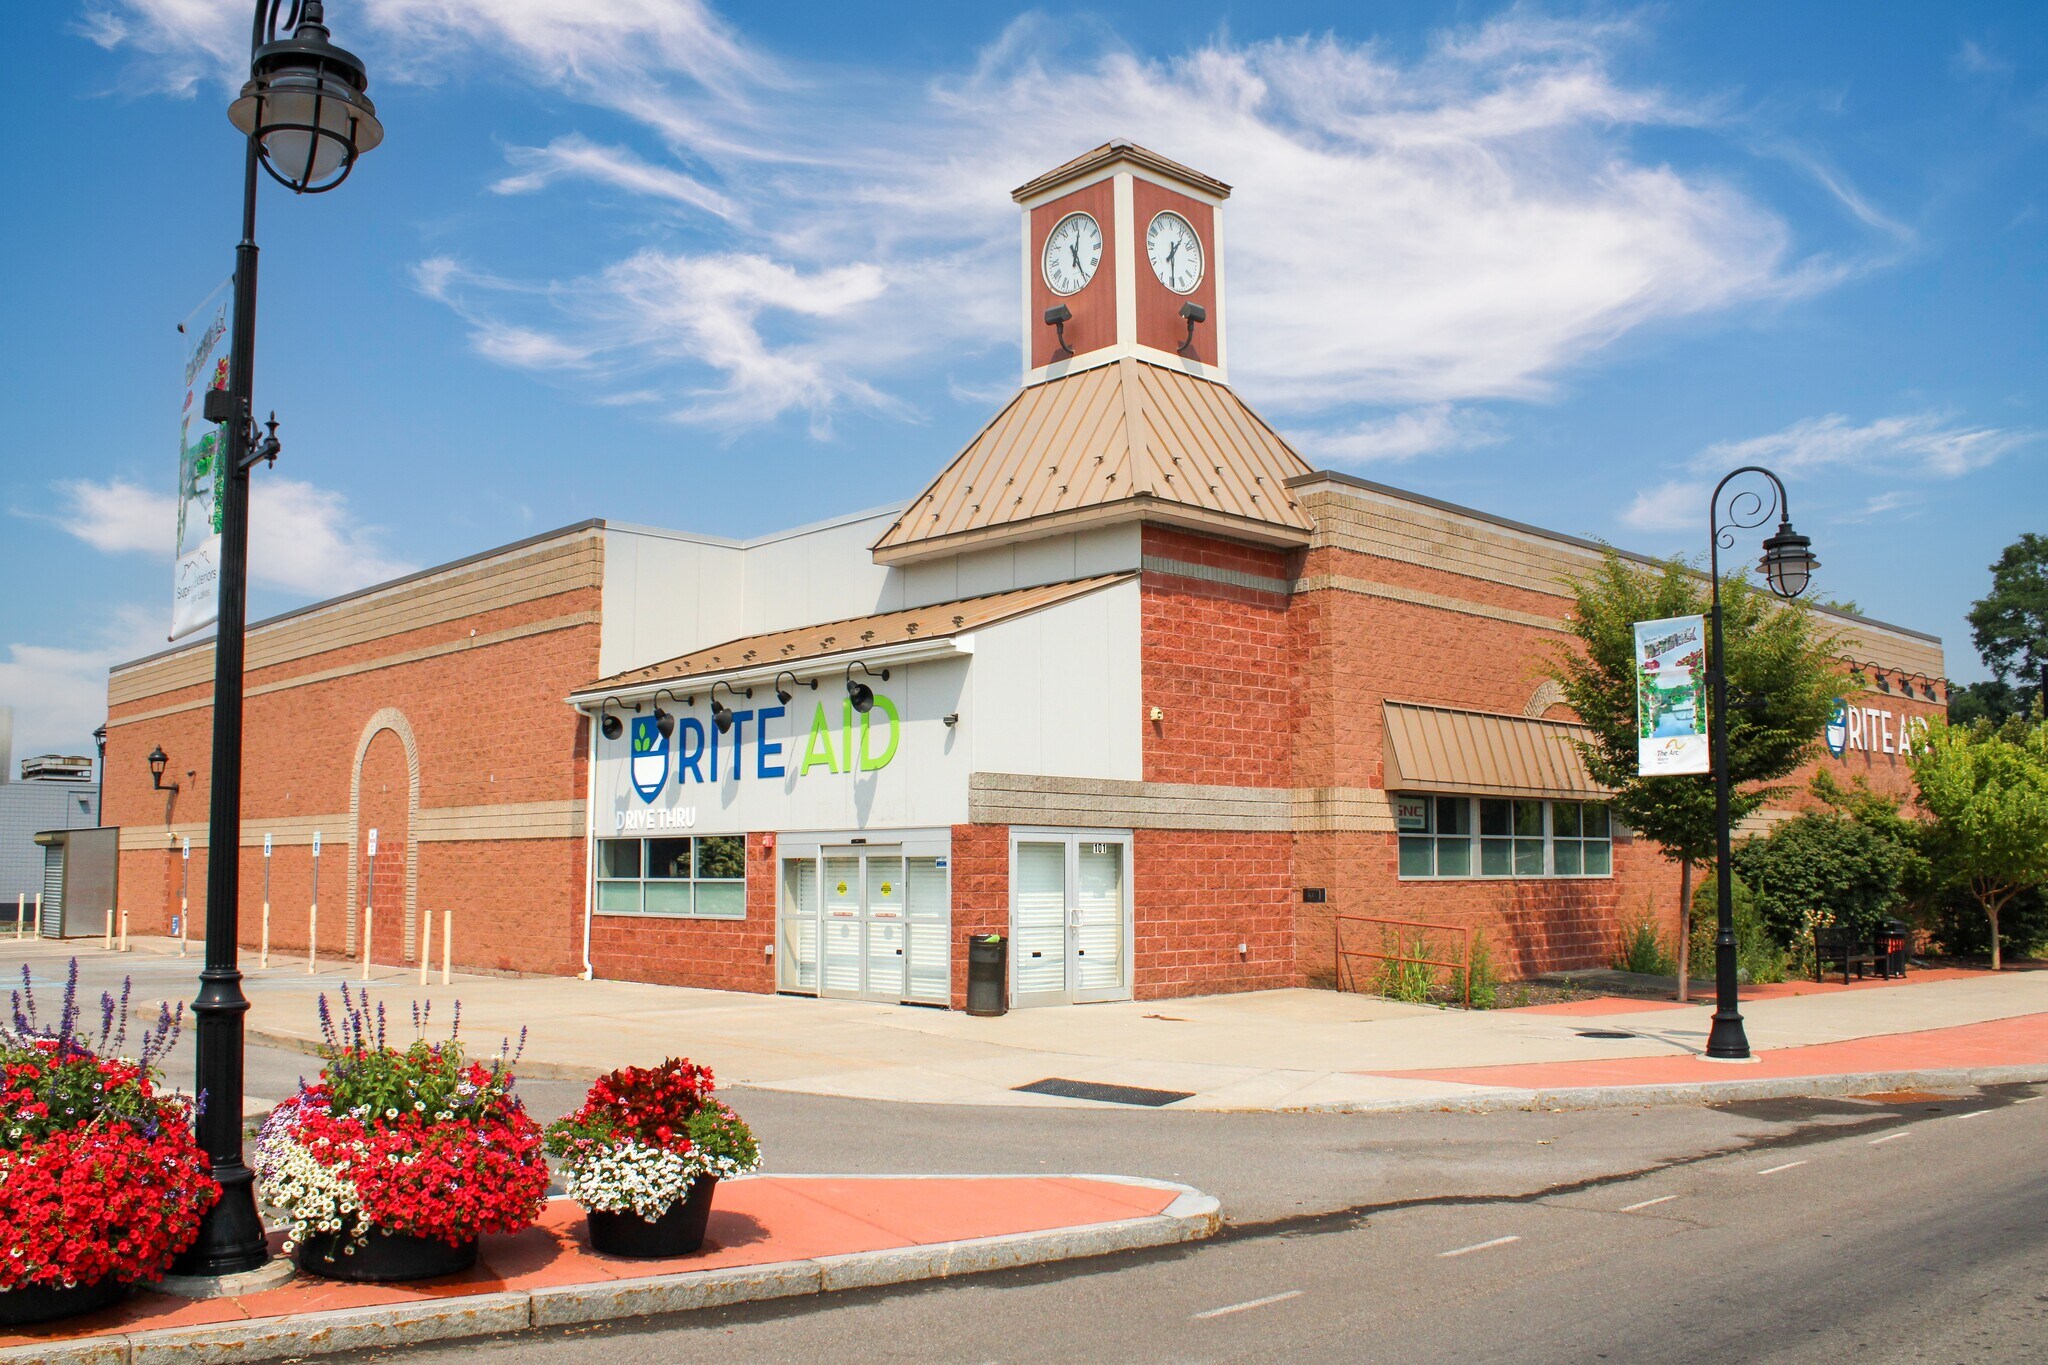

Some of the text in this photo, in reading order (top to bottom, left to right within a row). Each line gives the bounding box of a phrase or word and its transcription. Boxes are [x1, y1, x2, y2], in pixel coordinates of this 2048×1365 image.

[678, 694, 900, 784] RITE AID
[1847, 705, 1895, 754] RITE
[616, 806, 696, 830] DRIVE THRU
